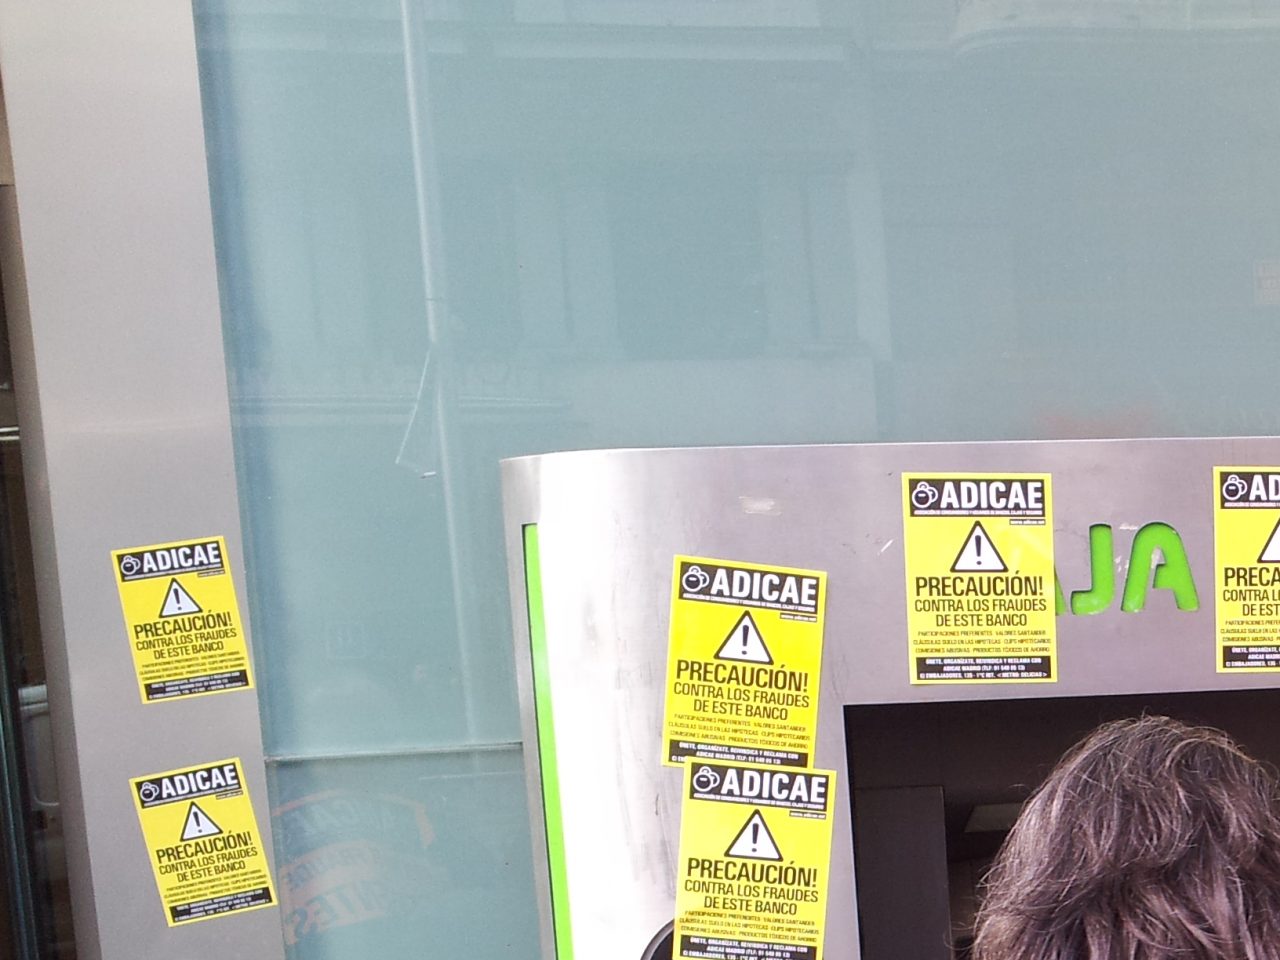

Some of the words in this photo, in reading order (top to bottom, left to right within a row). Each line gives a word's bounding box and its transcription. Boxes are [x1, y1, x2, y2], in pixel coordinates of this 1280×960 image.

[939, 481, 1043, 509] ADICAE
[142, 542, 221, 573] ADICAE
[709, 567, 817, 606] ADICAE
[915, 569, 1043, 597] PRECAUCIÓN!
[1222, 588, 1269, 602] CONTRA
[914, 598, 964, 612] CONTRA
[966, 598, 989, 612] LOS
[992, 598, 1047, 611] FRAUDES
[1242, 603, 1256, 616] DE
[133, 608, 232, 640] PRECAUCIÓN!
[935, 613, 951, 627] DE
[953, 613, 983, 627] ESTE
[985, 613, 1027, 626] BANCO
[135, 636, 174, 651] CONTRA
[174, 633, 193, 645] LOS
[193, 627, 237, 642] FRAUDES
[153, 648, 166, 660] DE
[166, 645, 190, 658] ESTE
[190, 640, 224, 654] BANCO
[676, 658, 808, 692] PRECAUCIÓN!
[673, 681, 724, 699] CONTRA
[726, 687, 750, 702] LOS
[752, 689, 809, 708] FRAUDES
[693, 698, 709, 713] DE
[711, 700, 742, 716] ESTE
[744, 703, 788, 720] BANCO
[161, 764, 238, 798] ADICAE
[720, 768, 826, 803] ADICAE
[155, 829, 253, 864] PRECAUCIÓN!
[158, 858, 197, 875] CONTRA
[196, 854, 215, 867] LOS
[215, 846, 258, 863] FRAUDES
[176, 871, 189, 882] DE
[189, 866, 213, 880] ESTE
[213, 859, 246, 875] BANCO
[686, 857, 817, 888] PRECAUCIÓN!
[684, 878, 734, 895] CONTRA
[737, 883, 760, 898] LOS
[762, 885, 818, 903] FRAUDES
[703, 895, 720, 909] DE
[722, 896, 752, 911] ESTE
[754, 899, 797, 915] BANCO
